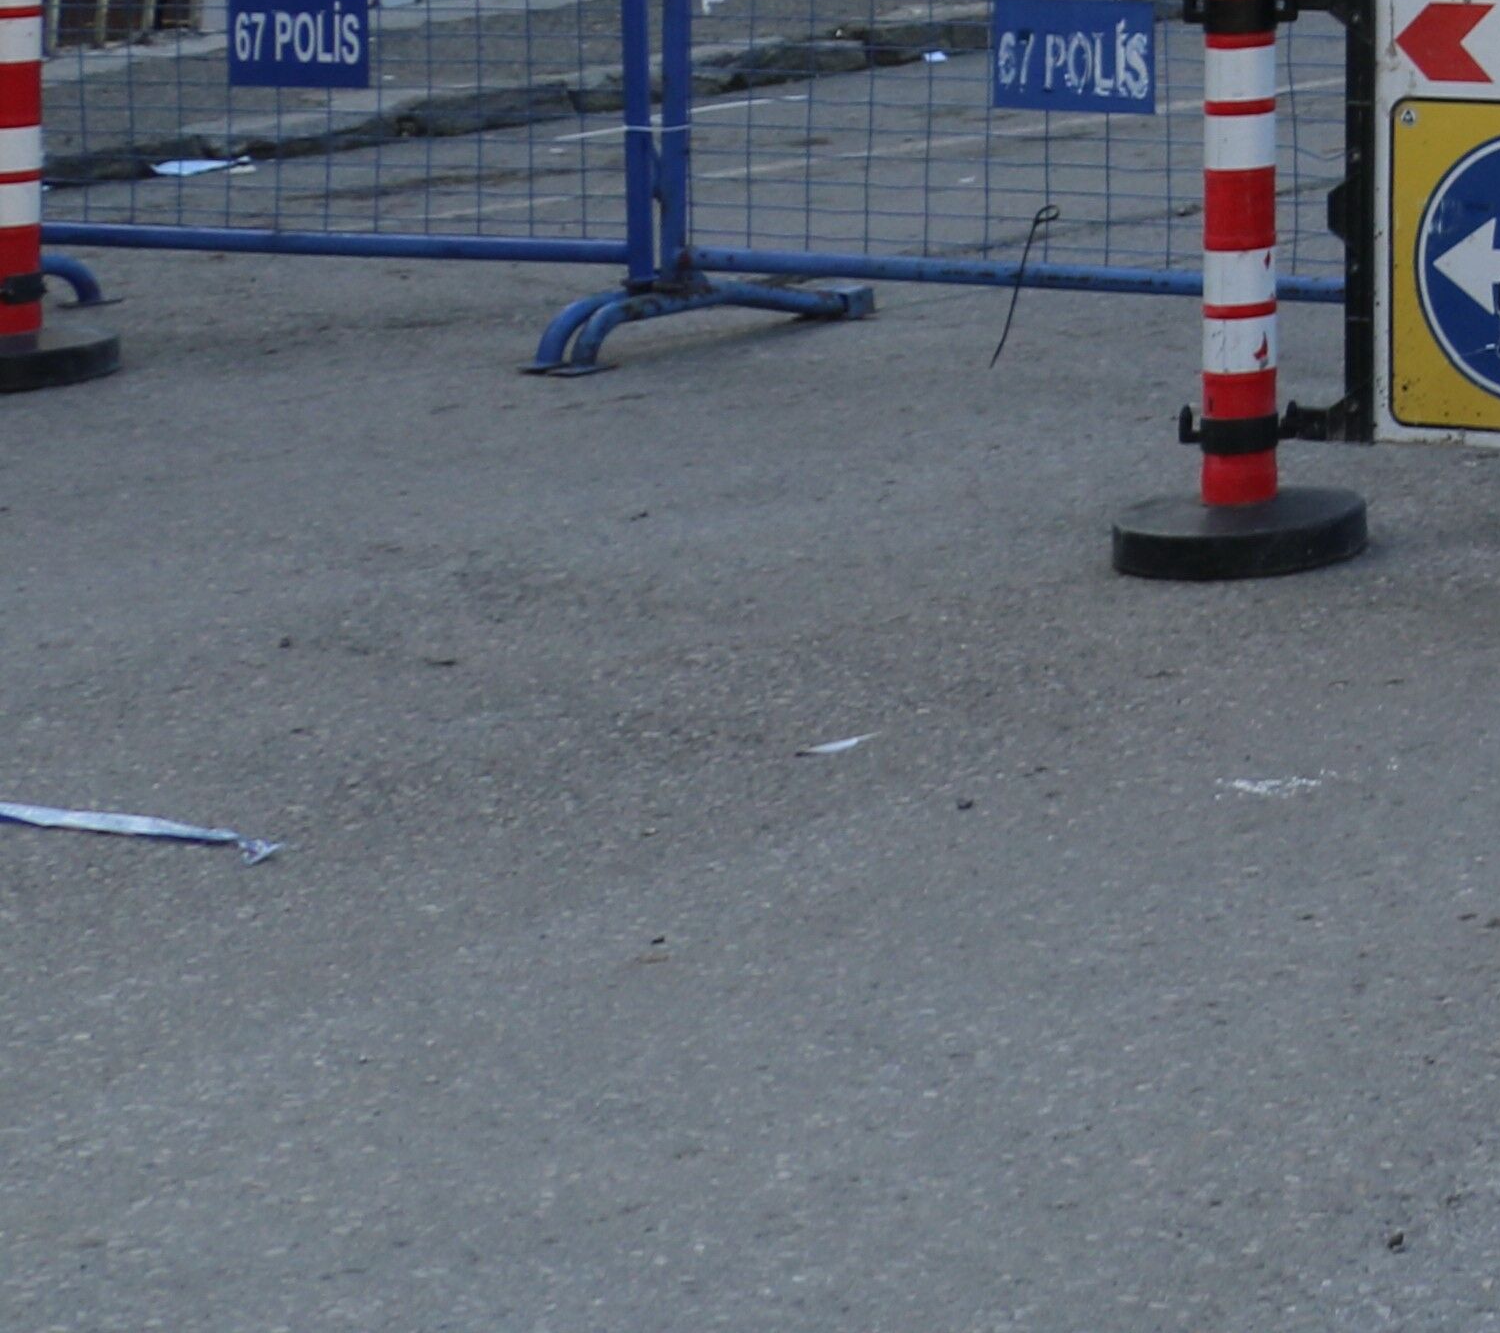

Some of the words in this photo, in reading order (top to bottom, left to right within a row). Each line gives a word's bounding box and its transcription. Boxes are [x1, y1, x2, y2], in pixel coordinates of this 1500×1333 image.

[235, 12, 266, 62] 67
[274, 1, 360, 64] POLİS
[999, 31, 1034, 91] 67
[1044, 20, 1150, 98] POLİS
